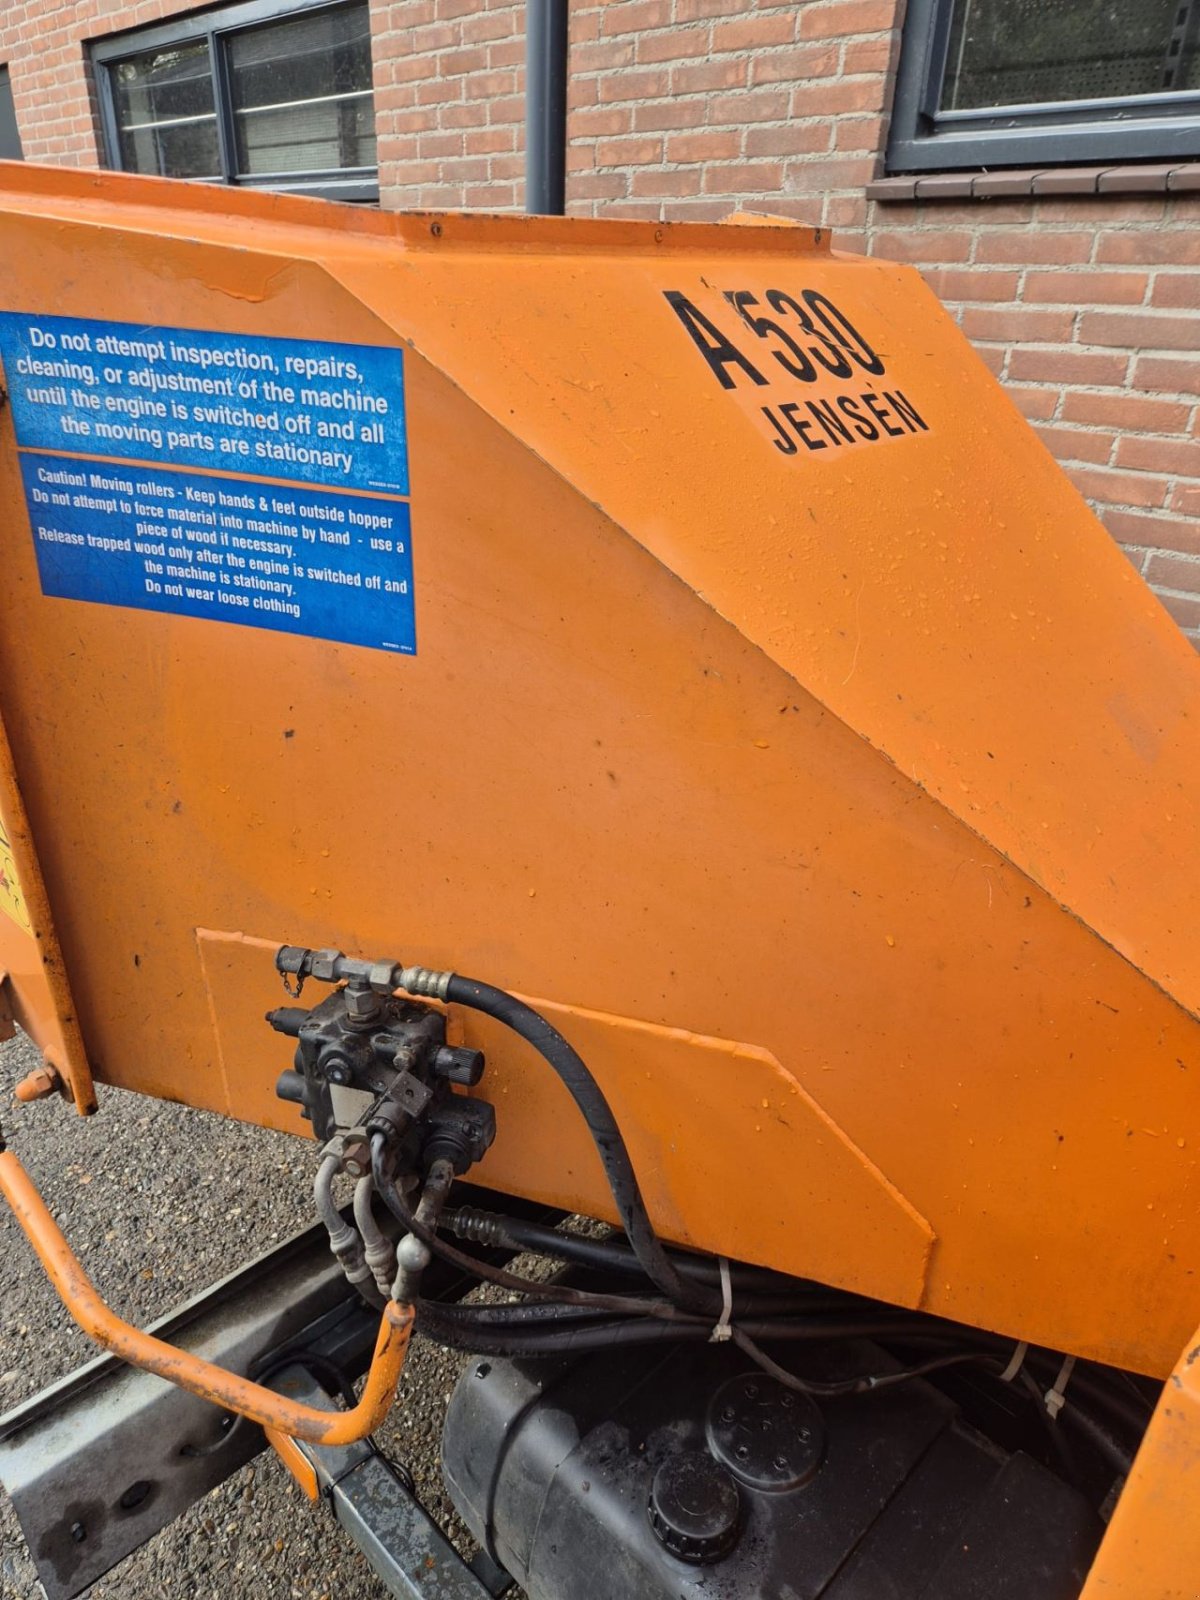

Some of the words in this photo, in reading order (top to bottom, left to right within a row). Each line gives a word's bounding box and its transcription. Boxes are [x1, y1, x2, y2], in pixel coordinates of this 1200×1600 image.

[30, 328, 56, 348] Do
[61, 333, 92, 352] not
[96, 336, 166, 363] attempt
[170, 341, 279, 375] inspection,
[285, 356, 363, 383] repairs,
[662, 291, 770, 390] A
[722, 289, 885, 382] 530
[17, 356, 99, 386] cleaning,
[104, 368, 122, 383] or
[129, 368, 233, 398] adjustment
[239, 380, 257, 398] of
[263, 382, 295, 403] the
[301, 388, 388, 414] machine
[27, 387, 67, 406] until
[71, 390, 100, 409] the
[106, 396, 167, 418] engine
[171, 401, 188, 419] is
[193, 405, 279, 431] switched
[285, 415, 311, 434] off
[317, 421, 354, 440] and
[361, 423, 384, 444] all
[760, 390, 930, 455] JENSEN
[61, 416, 90, 435] the
[96, 423, 162, 448] moving
[167, 431, 214, 450] parts
[220, 437, 249, 455] are
[255, 440, 352, 473] stationary
[33, 489, 48, 503] Do
[52, 492, 71, 506] not
[74, 495, 117, 514] attempt
[120, 502, 131, 514] to
[135, 501, 164, 517] force
[168, 507, 216, 525] material
[220, 513, 243, 529] into
[247, 519, 298, 537] machine
[302, 525, 315, 543] by
[320, 528, 350, 545] hand
[371, 538, 392, 551] use
[397, 541, 404, 553] a
[38, 468, 87, 487] Caution!
[90, 474, 133, 495] Moving
[137, 483, 174, 498] rollers
[186, 487, 215, 506] Keep
[219, 491, 255, 509] hands
[259, 497, 268, 511] &
[272, 499, 296, 515] feet
[300, 505, 344, 522] outside
[349, 510, 393, 529] hopper
[38, 527, 84, 545] Release
[87, 533, 130, 552] trapped
[134, 541, 165, 556] wood
[169, 546, 192, 562] only
[197, 549, 223, 564] after
[227, 553, 245, 567] the
[250, 559, 289, 575] engine
[293, 564, 303, 577] is
[308, 568, 361, 586] switched
[365, 575, 381, 589] off
[385, 580, 407, 593] and
[136, 523, 167, 537] piece
[172, 526, 183, 538] of
[186, 531, 217, 544] wood
[220, 532, 228, 546] if
[232, 536, 296, 559] necessary.
[144, 560, 163, 574] the
[167, 565, 216, 582] machine
[220, 571, 230, 585] is
[234, 574, 296, 597] stationary.
[145, 579, 161, 593] Do
[165, 583, 183, 596] not
[186, 589, 213, 601] wear
[218, 590, 249, 607] loose
[253, 599, 300, 618] clothing
